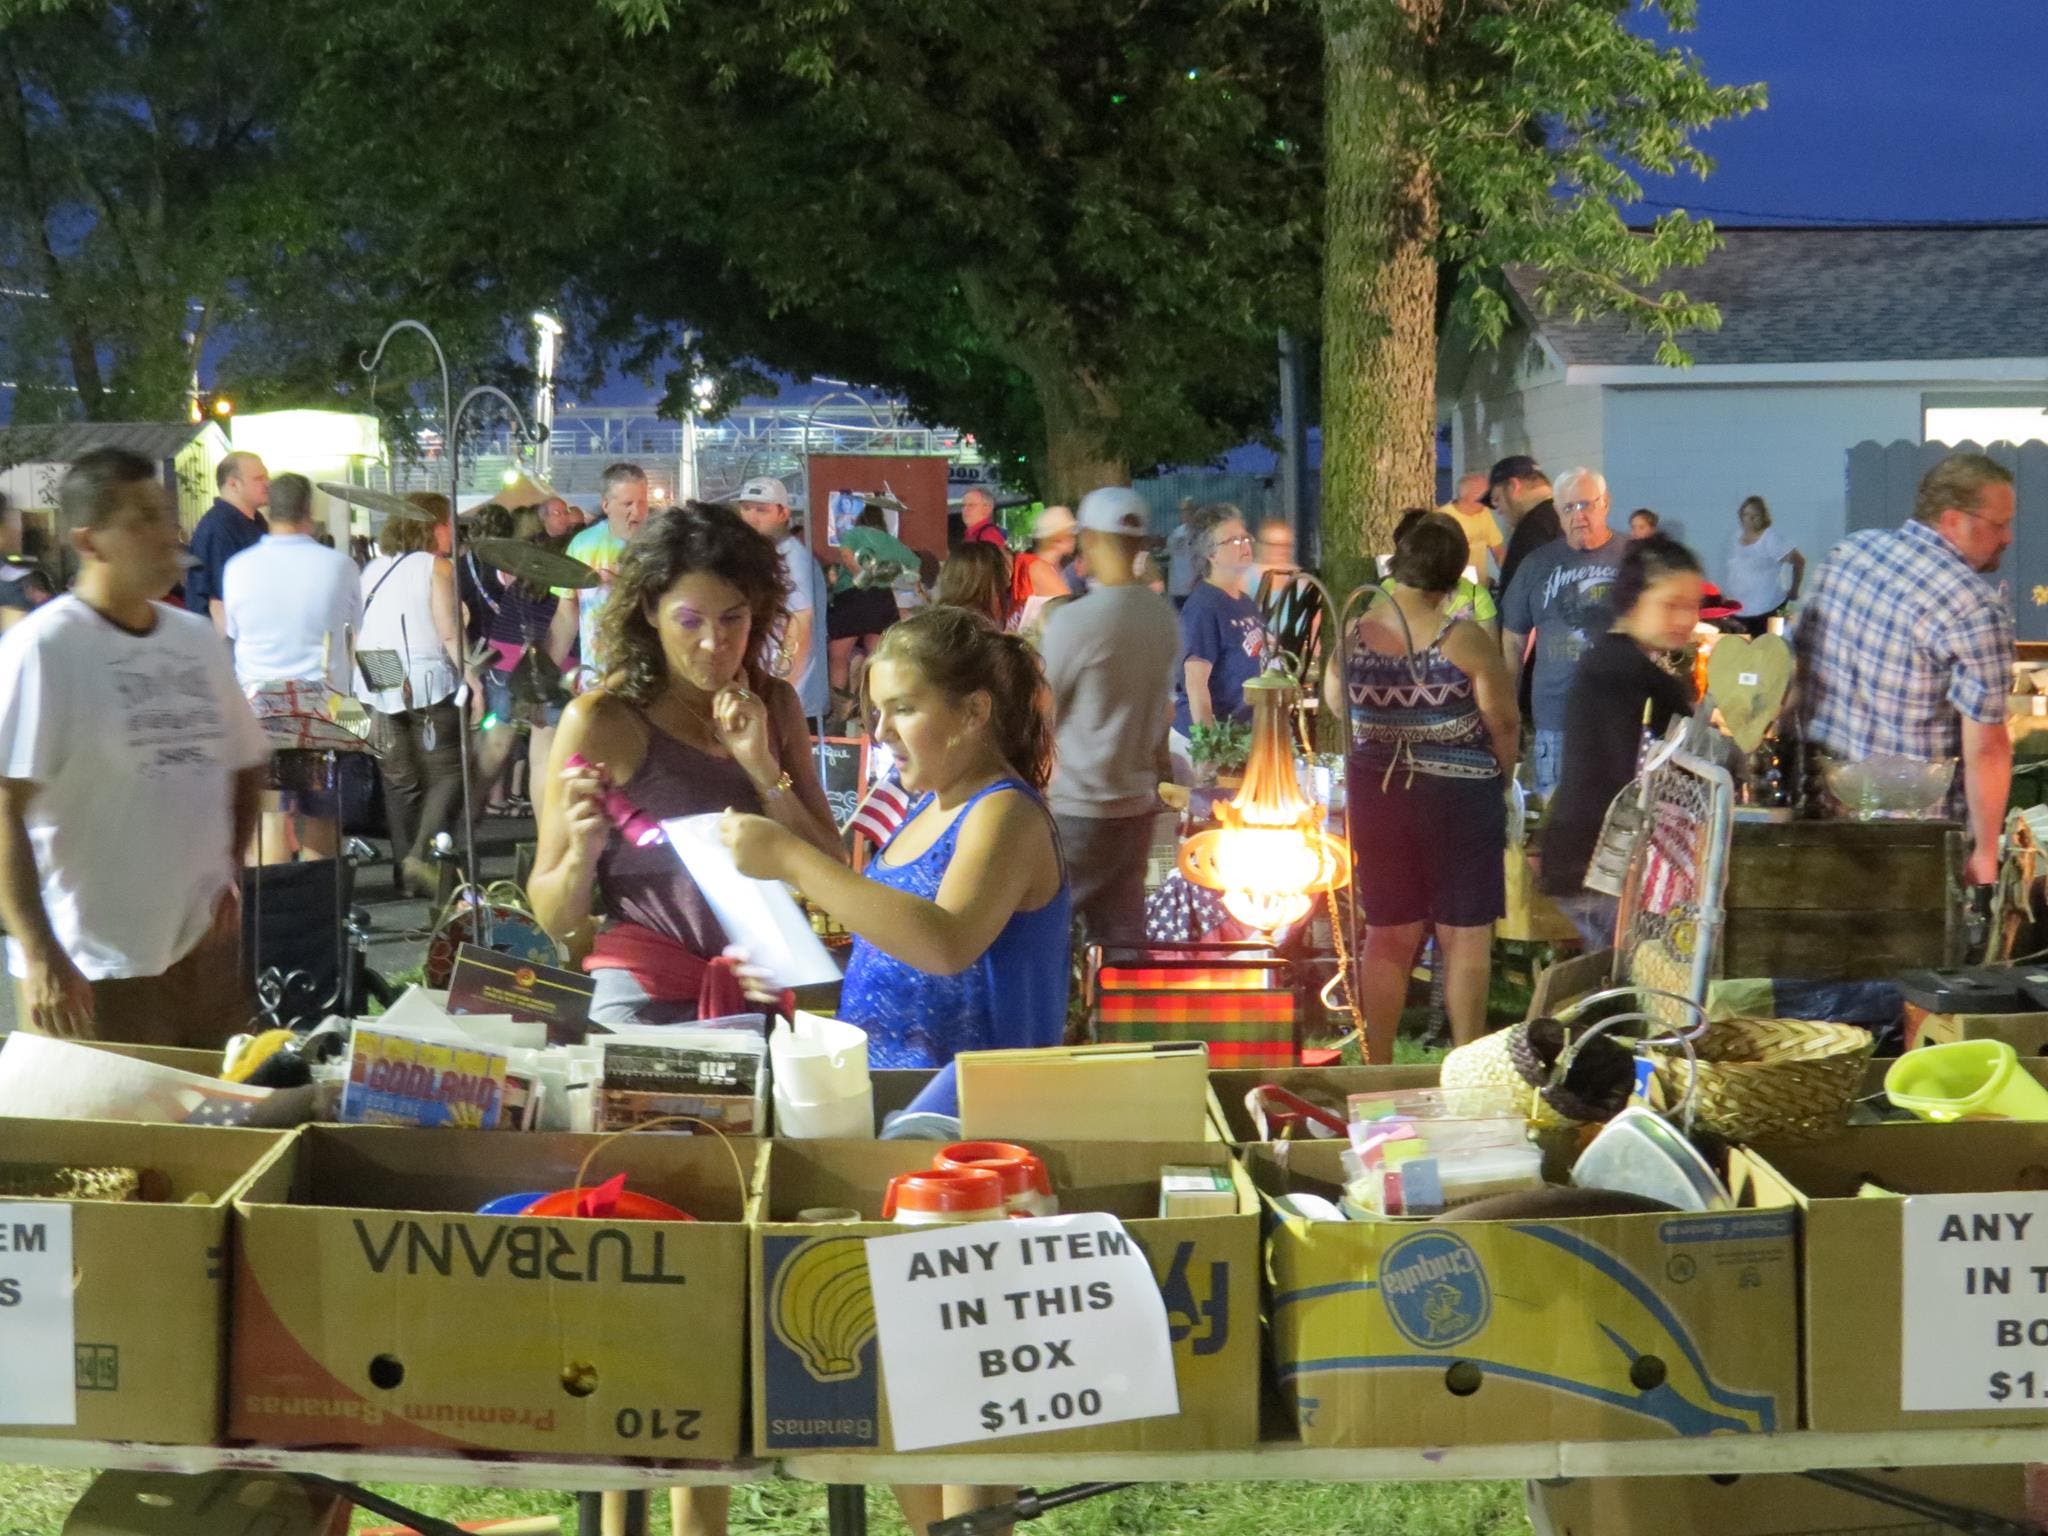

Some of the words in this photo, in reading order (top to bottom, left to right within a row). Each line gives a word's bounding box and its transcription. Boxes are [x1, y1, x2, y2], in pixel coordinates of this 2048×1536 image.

[1939, 1213, 2033, 1242] ANY
[353, 1219, 686, 1284] TURBANA
[907, 1241, 999, 1281] ANY
[1020, 1230, 1131, 1265] ITEM
[1382, 1247, 1476, 1295] Chiquita
[1966, 1267, 2010, 1294] IN
[941, 1298, 987, 1330] IN
[1004, 1281, 1114, 1320] THIS
[979, 1339, 1075, 1378] BOX
[247, 1395, 383, 1425] Bananas
[403, 1404, 556, 1431] Premium
[616, 1408, 701, 1440] 210
[981, 1388, 1101, 1432] $1.00
[771, 1419, 871, 1438] Bananas
